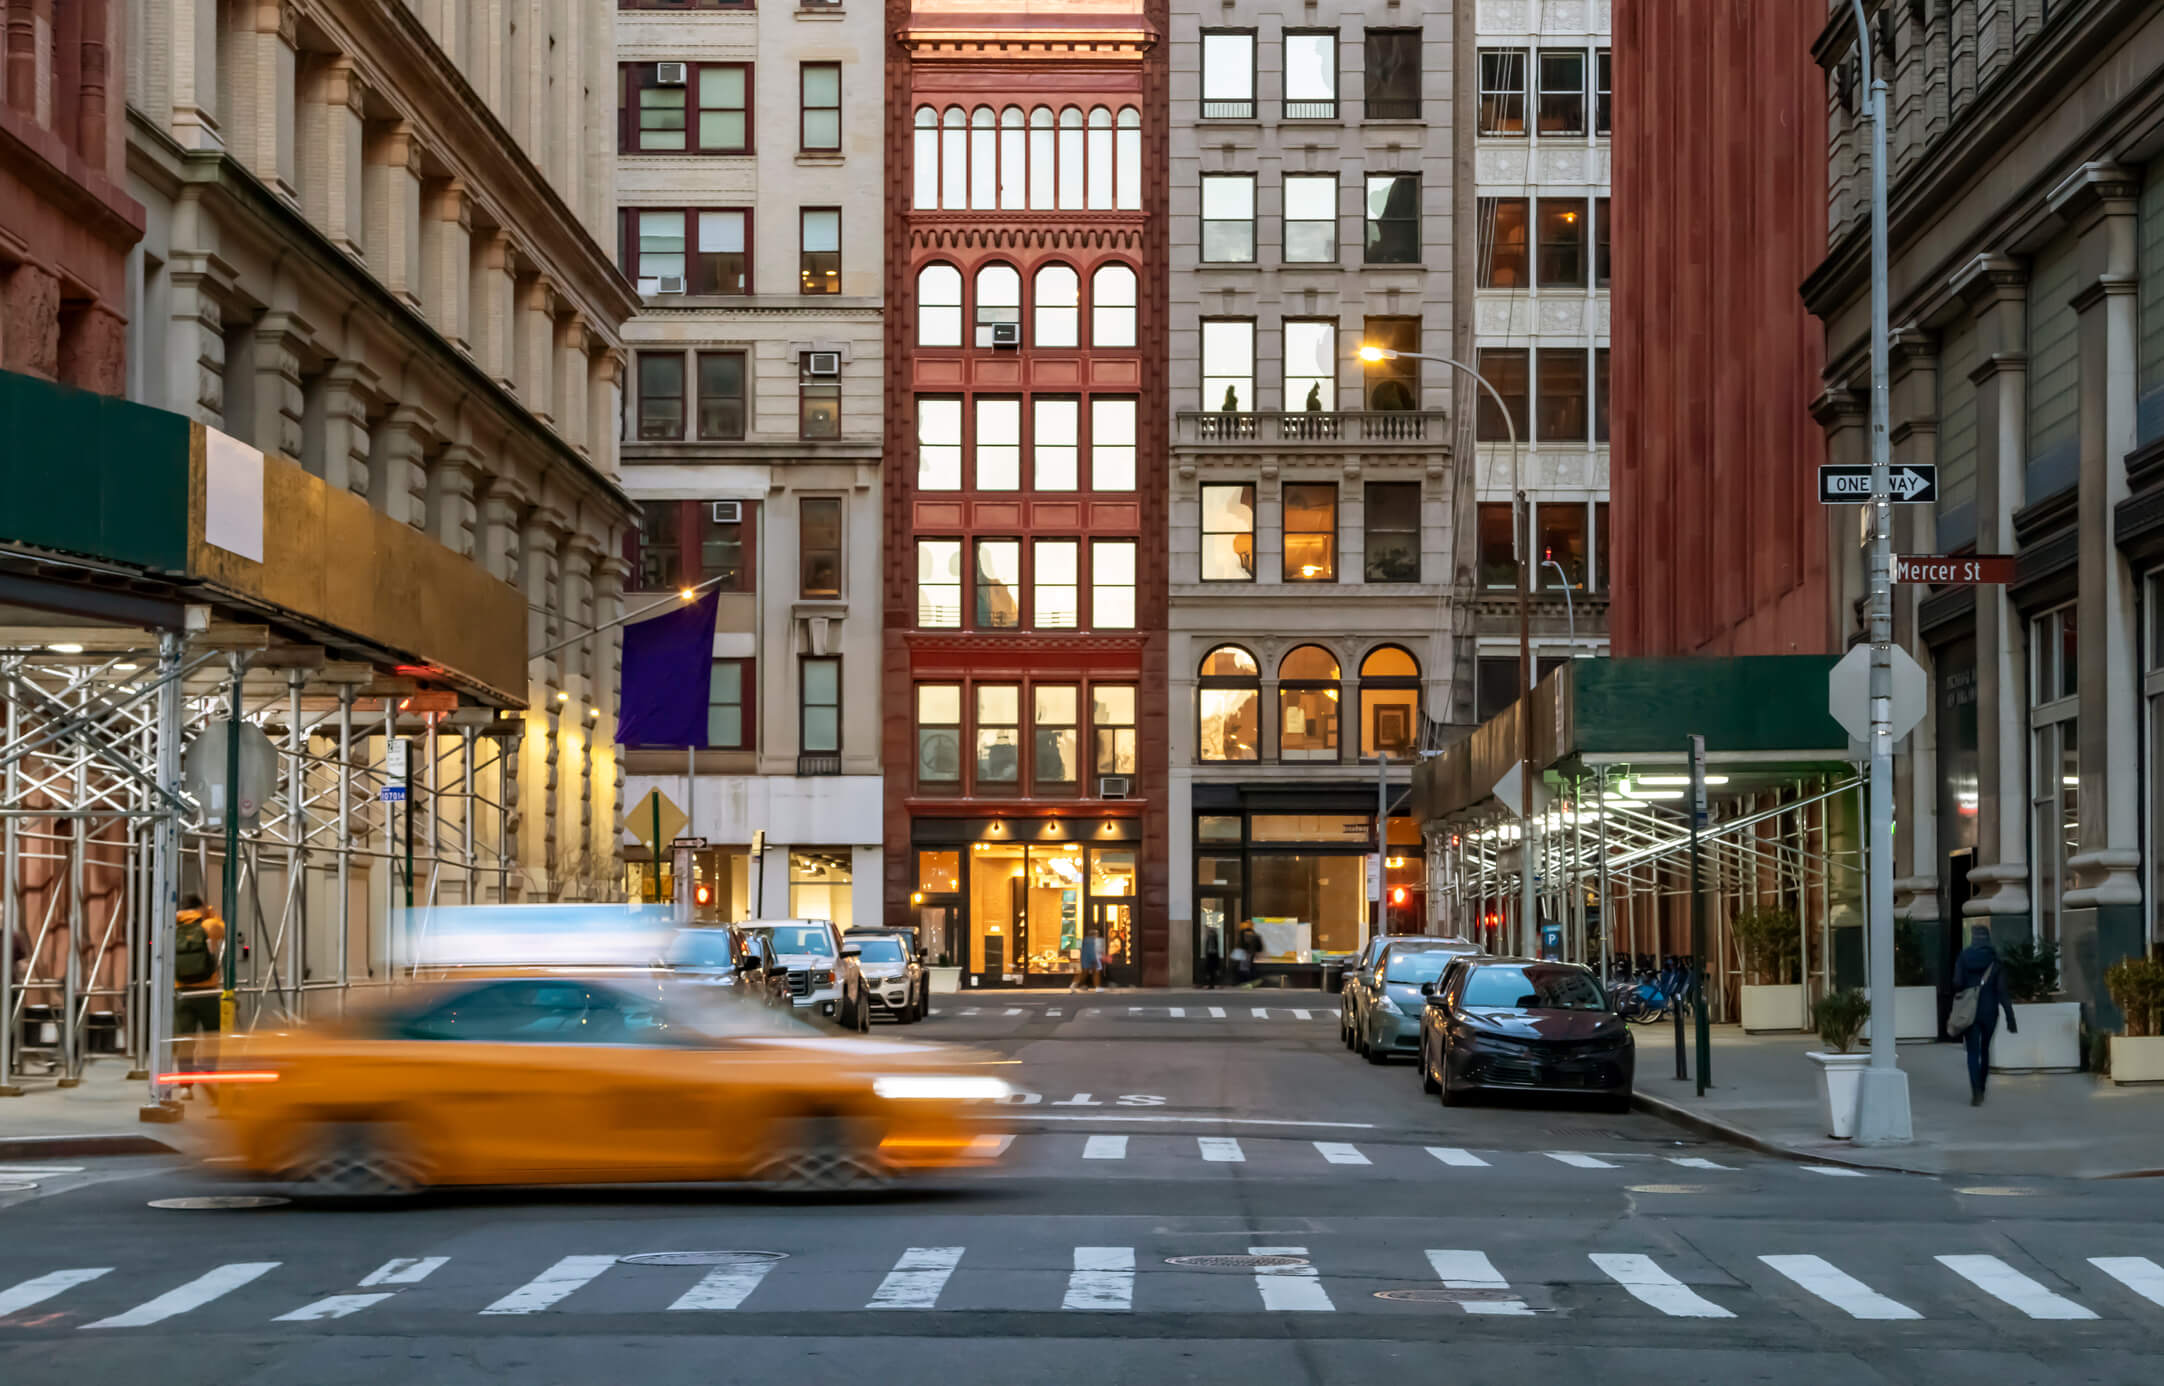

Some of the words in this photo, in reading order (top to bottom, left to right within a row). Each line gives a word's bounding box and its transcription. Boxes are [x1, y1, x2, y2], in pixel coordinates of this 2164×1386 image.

[1836, 477, 1869, 491] ONE
[1897, 561, 1956, 580] Mercer
[1964, 561, 1981, 581] St
